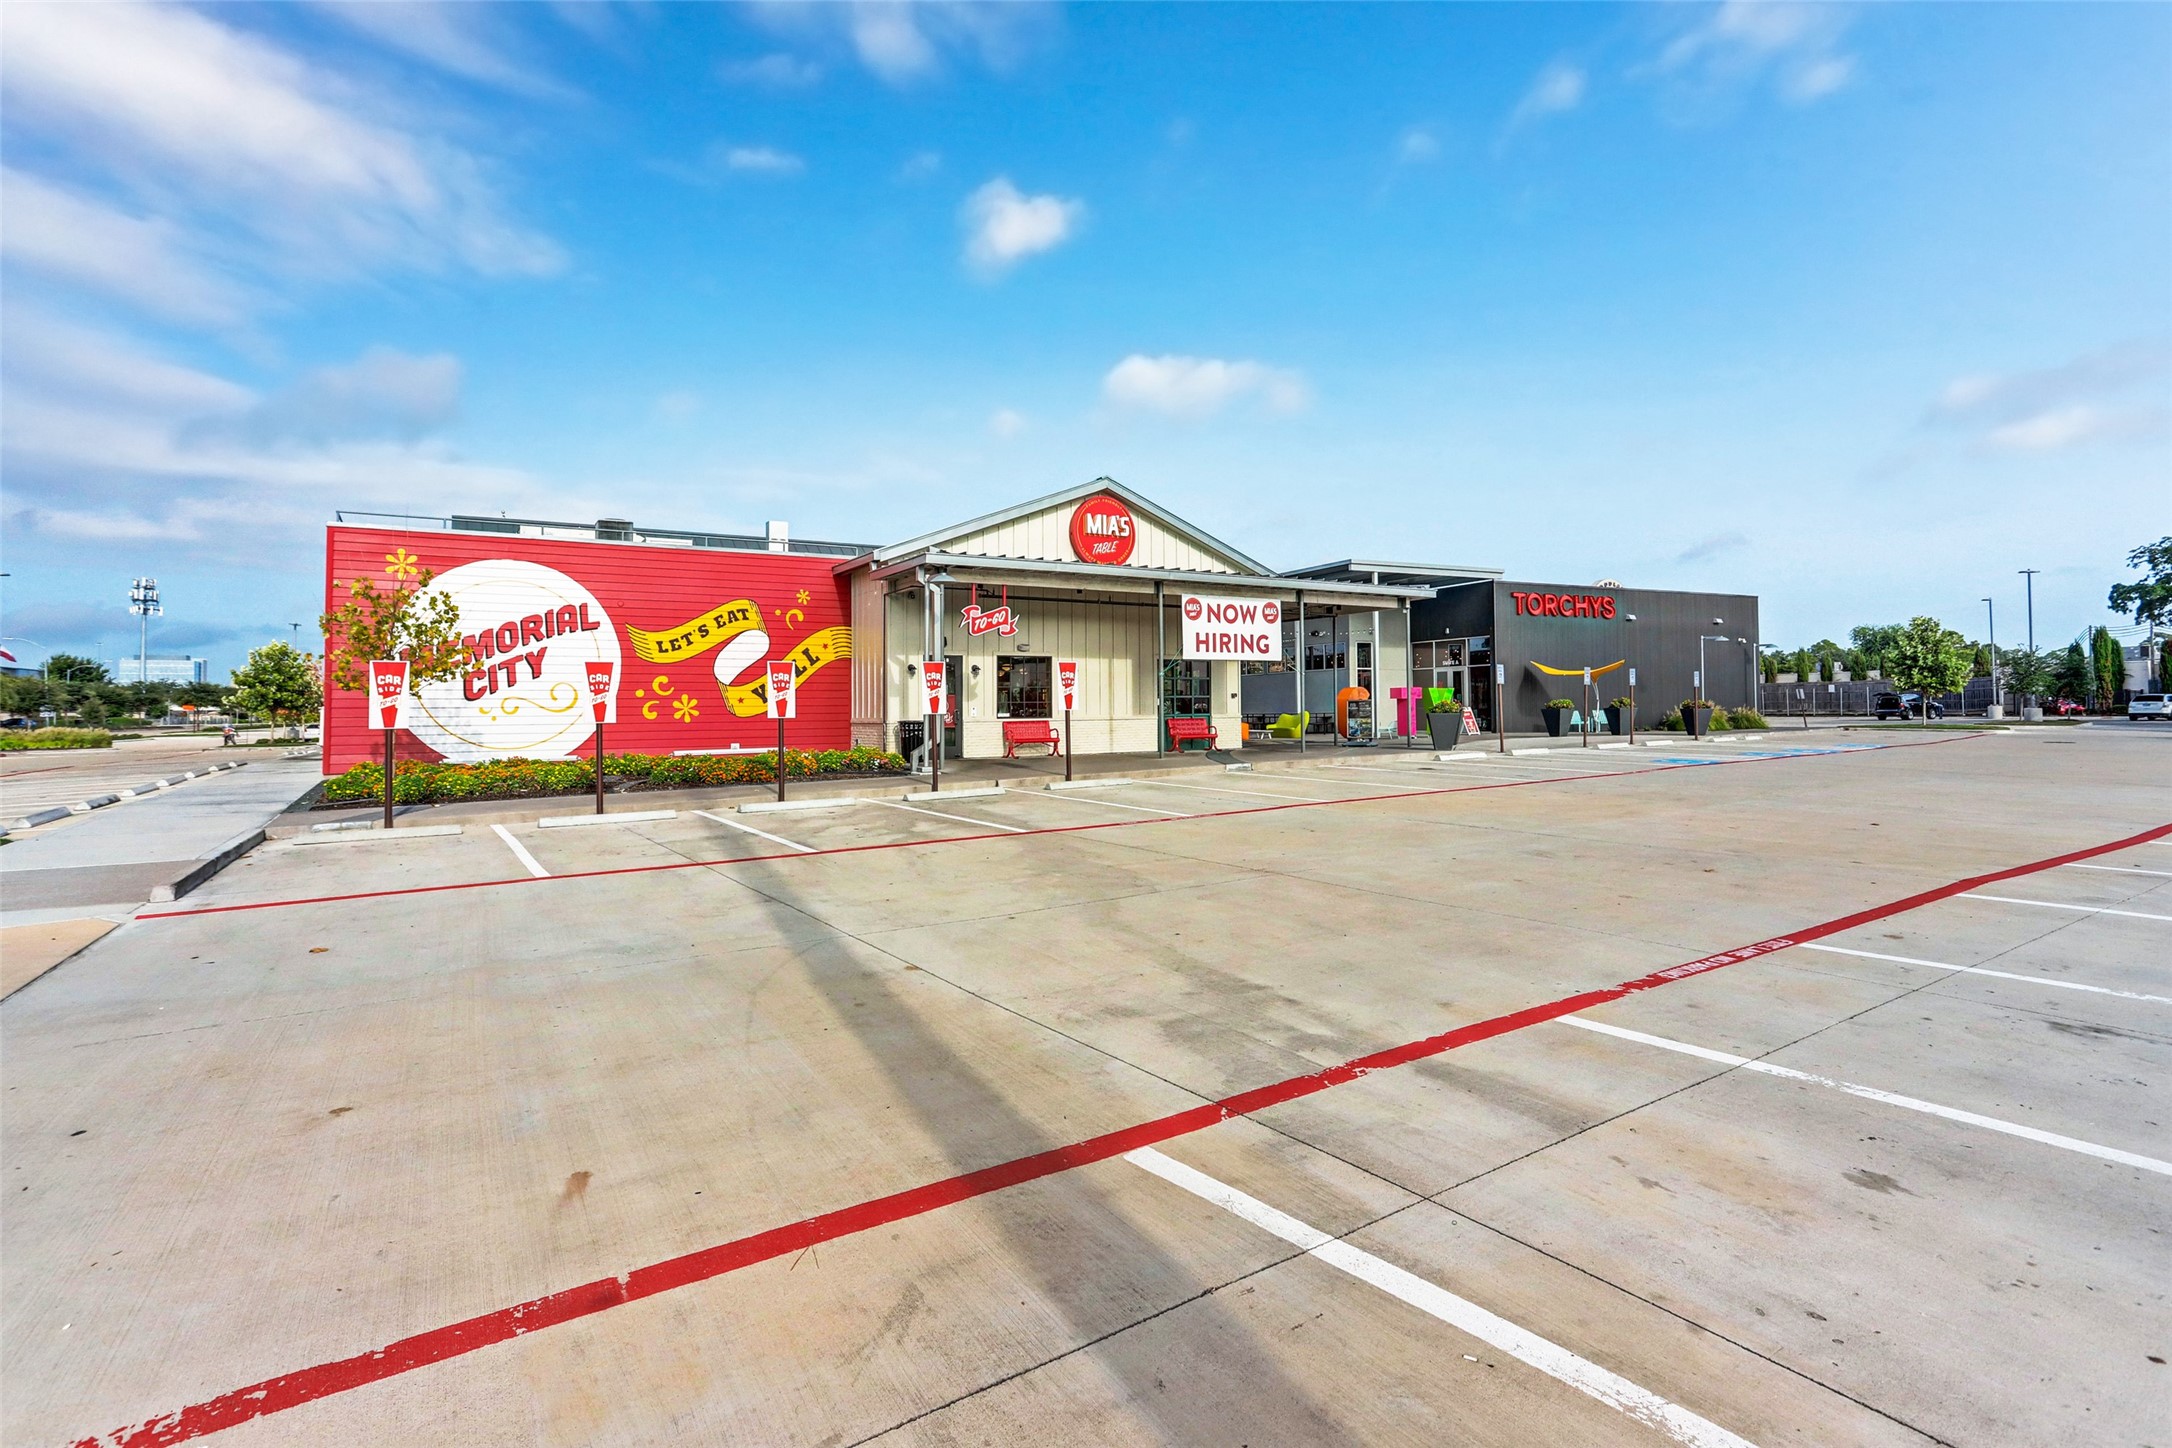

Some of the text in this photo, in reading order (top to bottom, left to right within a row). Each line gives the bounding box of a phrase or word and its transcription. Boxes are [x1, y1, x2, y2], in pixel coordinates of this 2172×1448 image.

[1084, 512, 1130, 537] MIA'S
[1092, 541, 1119, 554] TABLE
[1207, 603, 1257, 624] NOW
[1511, 592, 1616, 619] TORCHYS
[656, 608, 750, 654] LET'S EAT
[974, 611, 1006, 631] TO-GO
[1195, 632, 1269, 654] HIRING
[377, 674, 402, 685] CAR
[463, 646, 548, 701] CITY
[589, 673, 610, 683] CAR
[751, 647, 820, 704] YLL
[772, 672, 790, 682] CAR
[926, 672, 942, 680] CAR
